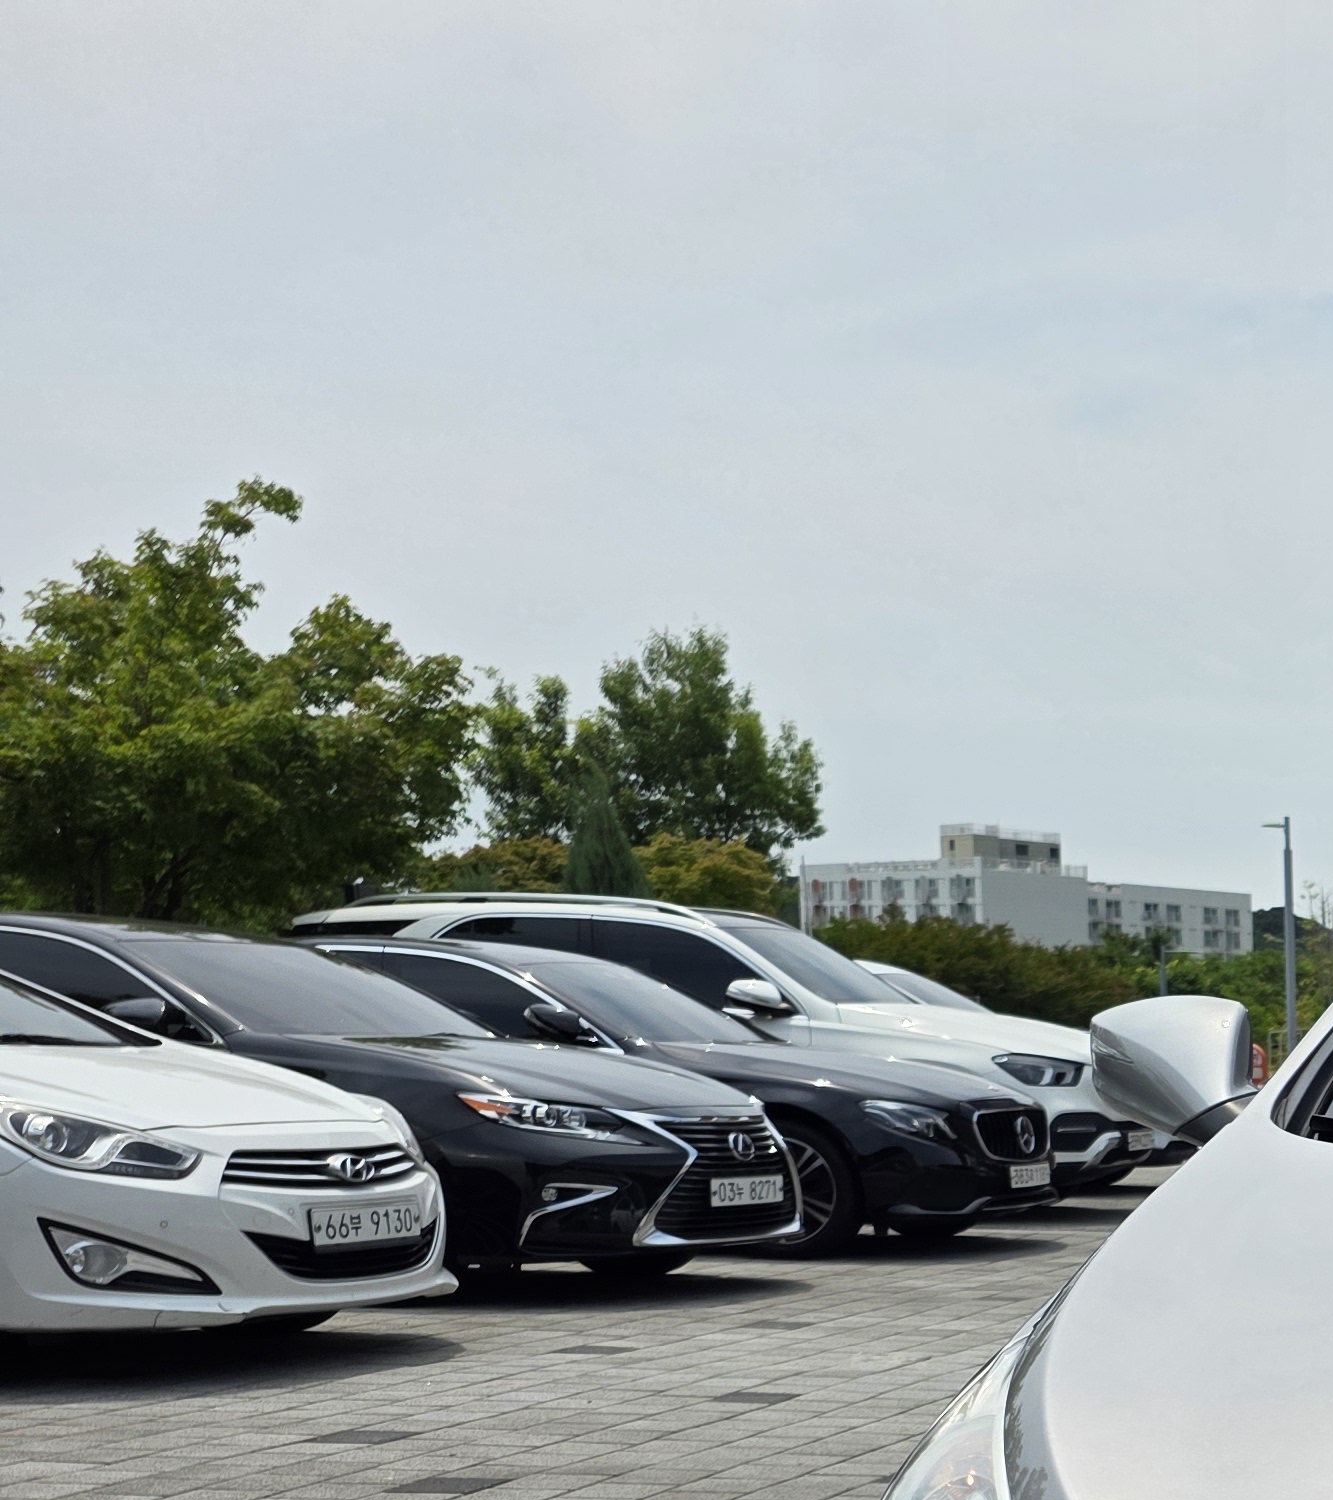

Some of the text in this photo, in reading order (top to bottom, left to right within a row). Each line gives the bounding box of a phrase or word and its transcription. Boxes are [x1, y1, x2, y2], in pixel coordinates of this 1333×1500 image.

[749, 1180, 777, 1201] 8271
[325, 1207, 413, 1239] 66부 9130
